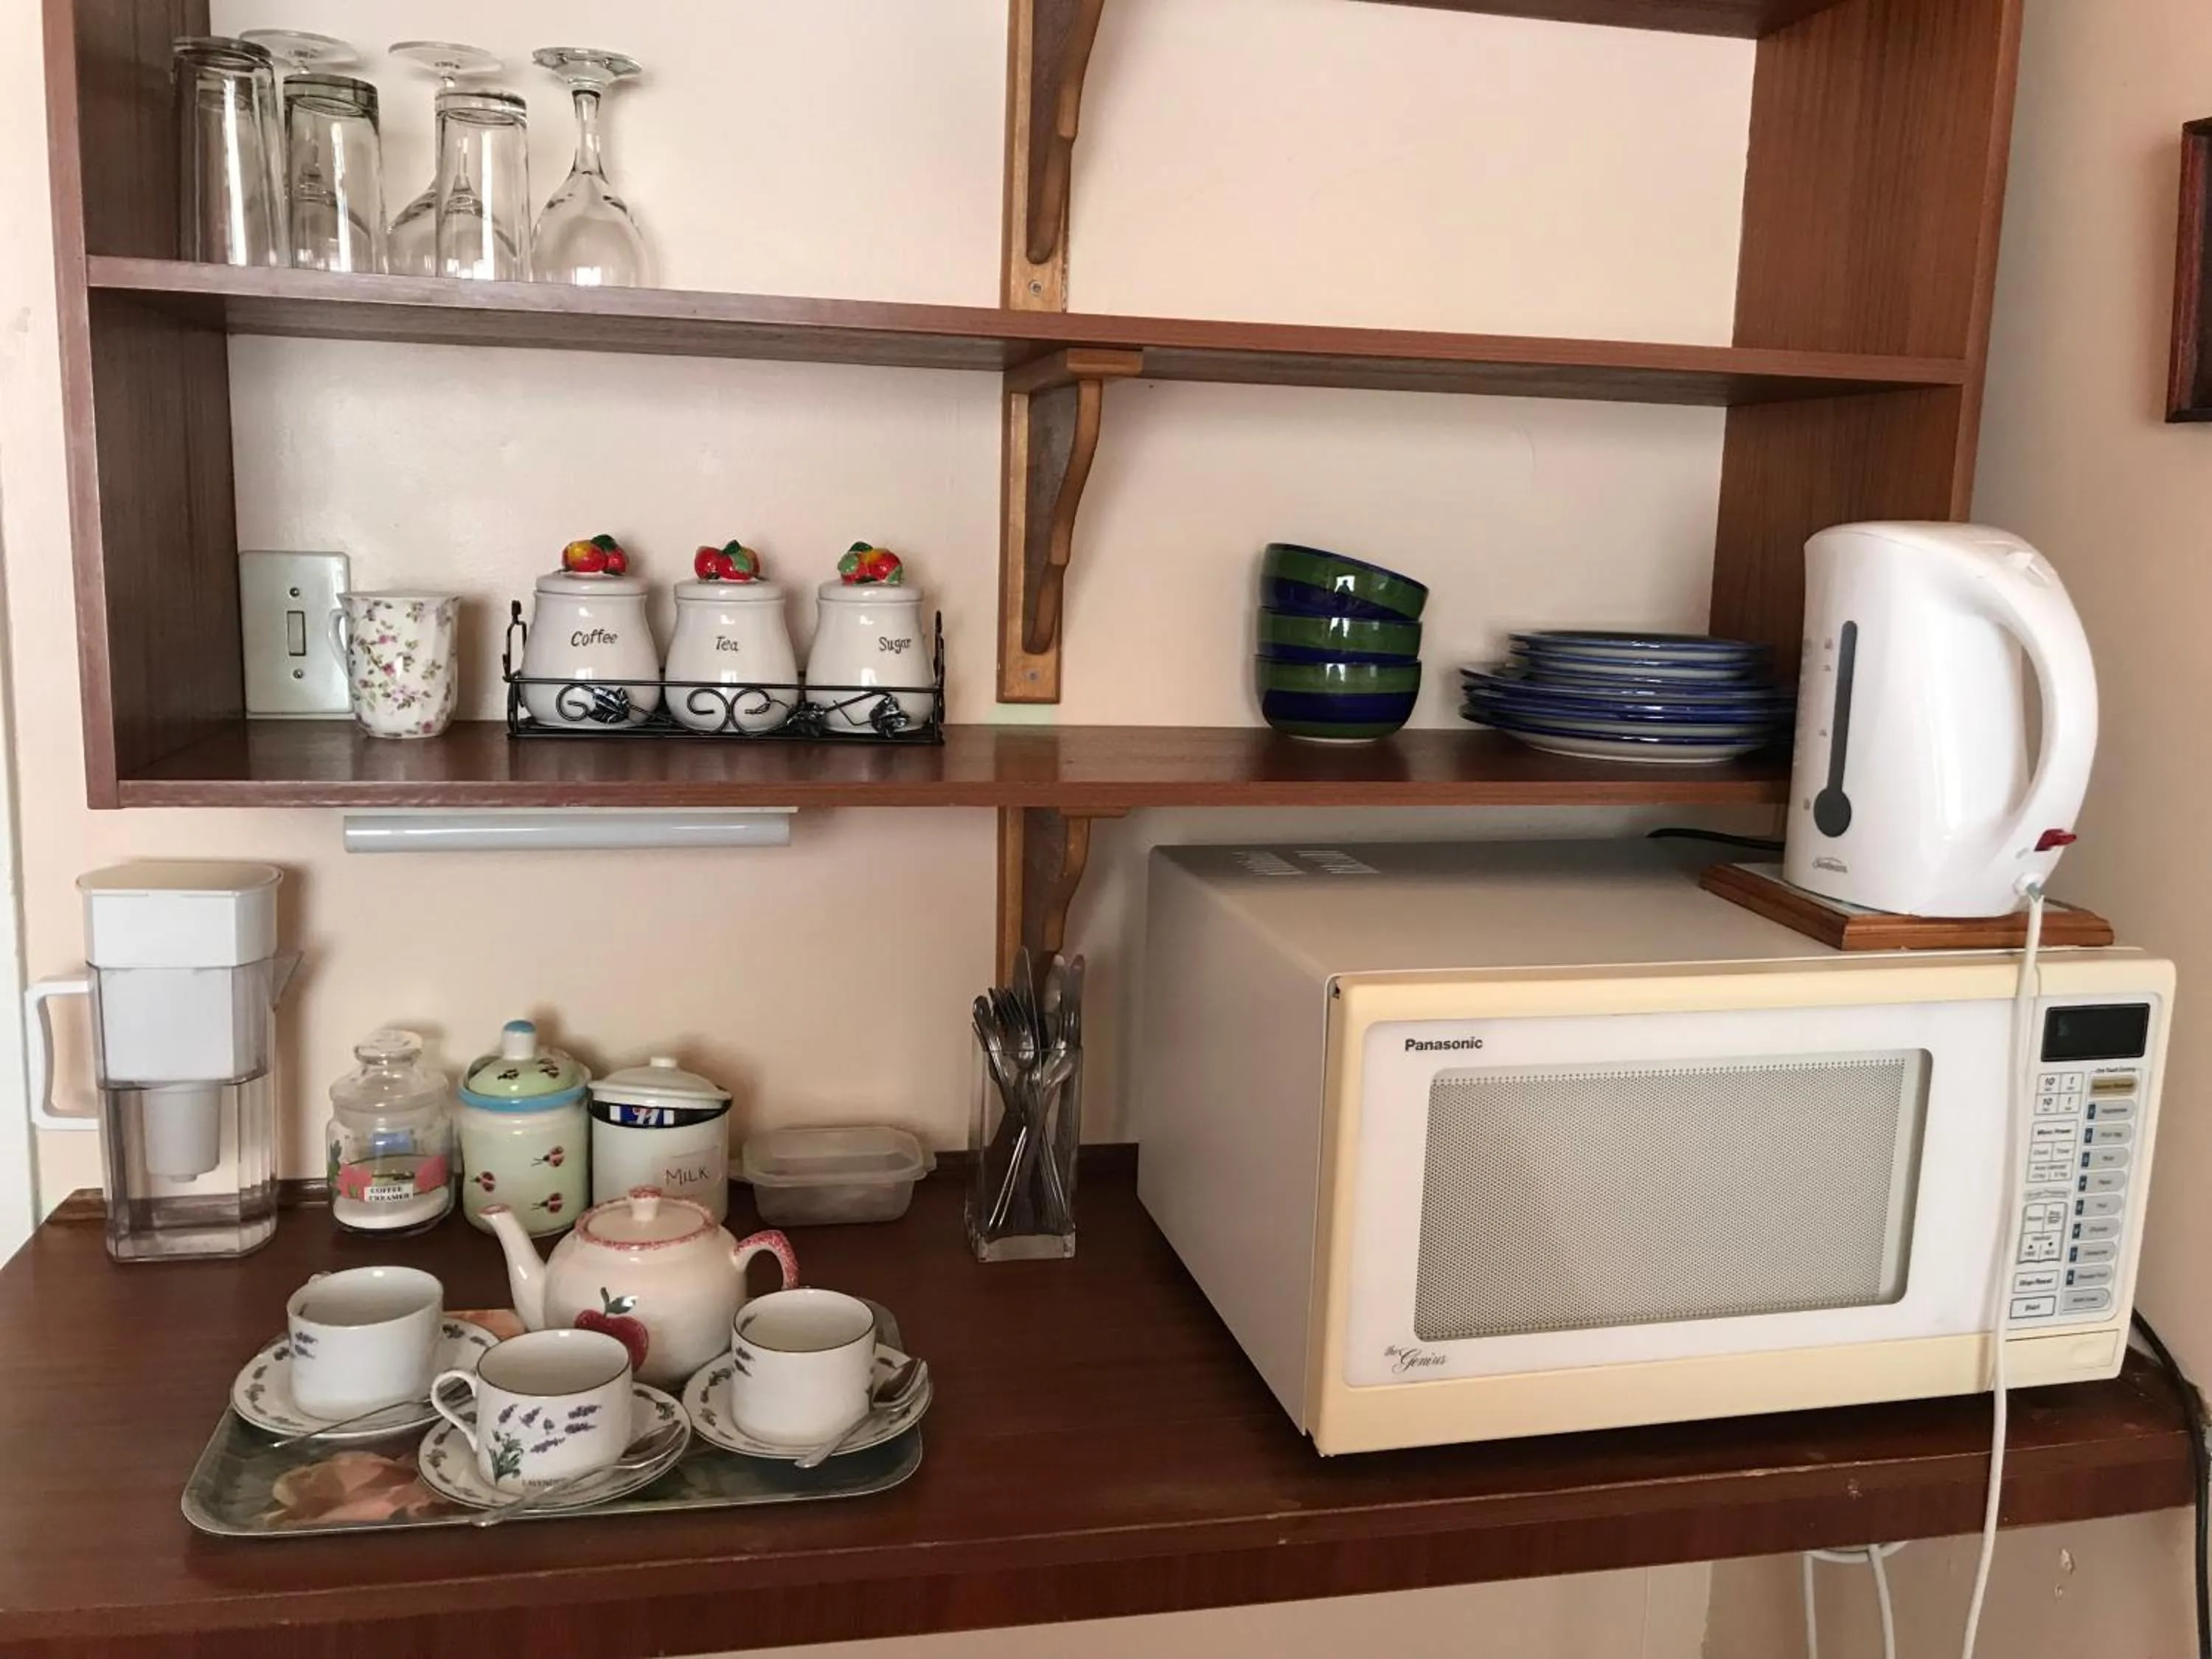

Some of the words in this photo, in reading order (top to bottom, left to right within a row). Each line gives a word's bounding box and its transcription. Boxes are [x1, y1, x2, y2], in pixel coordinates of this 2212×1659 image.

[571, 628, 618, 647] Coffee
[715, 636, 739, 652] Tea
[878, 636, 911, 654] Sugar
[1405, 1037, 1483, 1051] Panasonic
[666, 1166, 709, 1186] MILK
[1392, 1348, 1445, 1374] Genius
